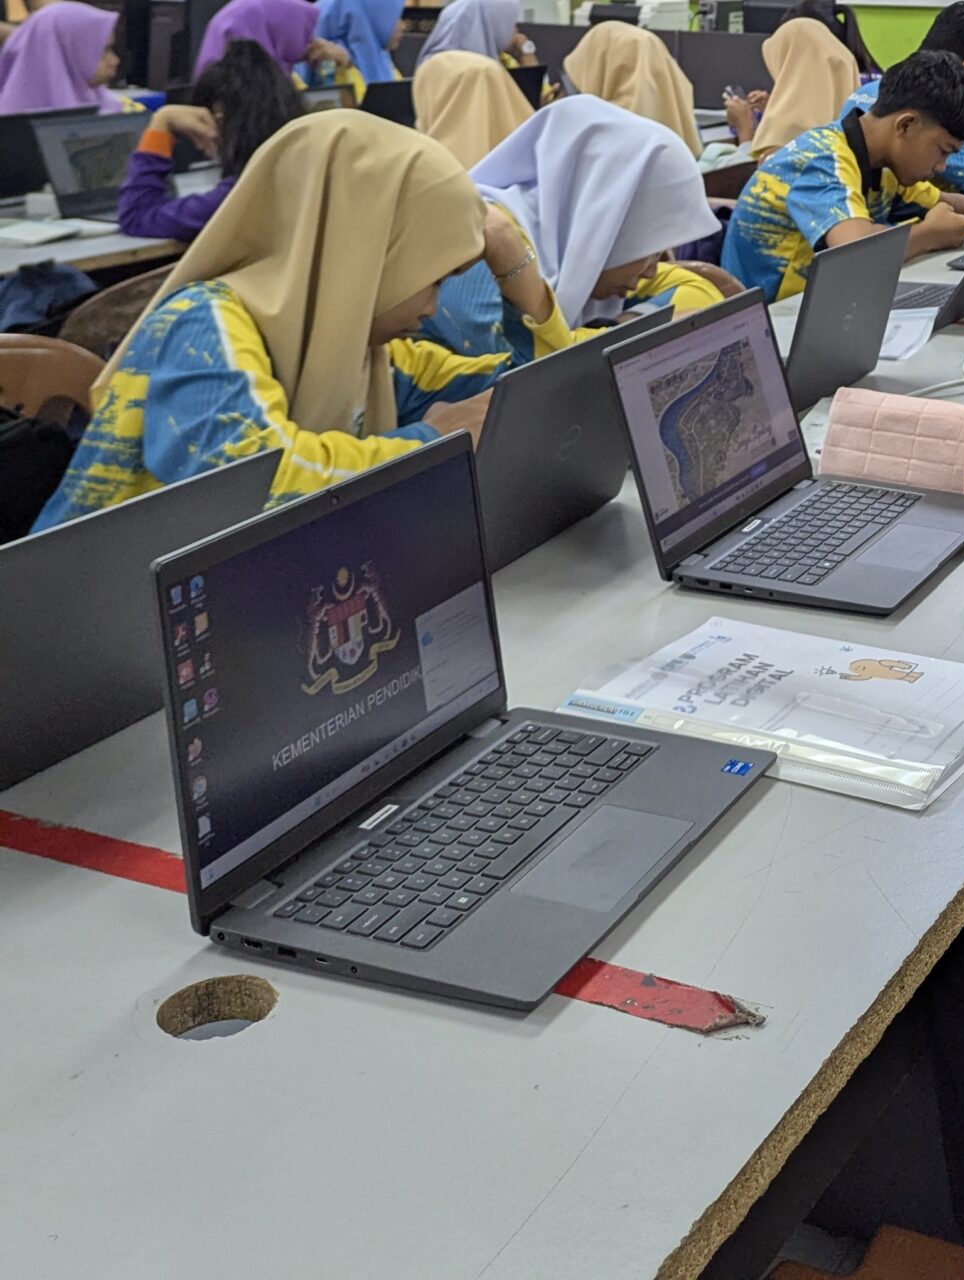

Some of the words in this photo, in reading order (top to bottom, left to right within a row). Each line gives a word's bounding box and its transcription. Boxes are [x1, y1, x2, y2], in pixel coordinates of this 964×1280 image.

[677, 652, 760, 704] PROGRAM
[703, 661, 775, 705] LATIHAN
[729, 669, 795, 707] DIGITAL
[271, 699, 366, 771] KEMENTERIAN
